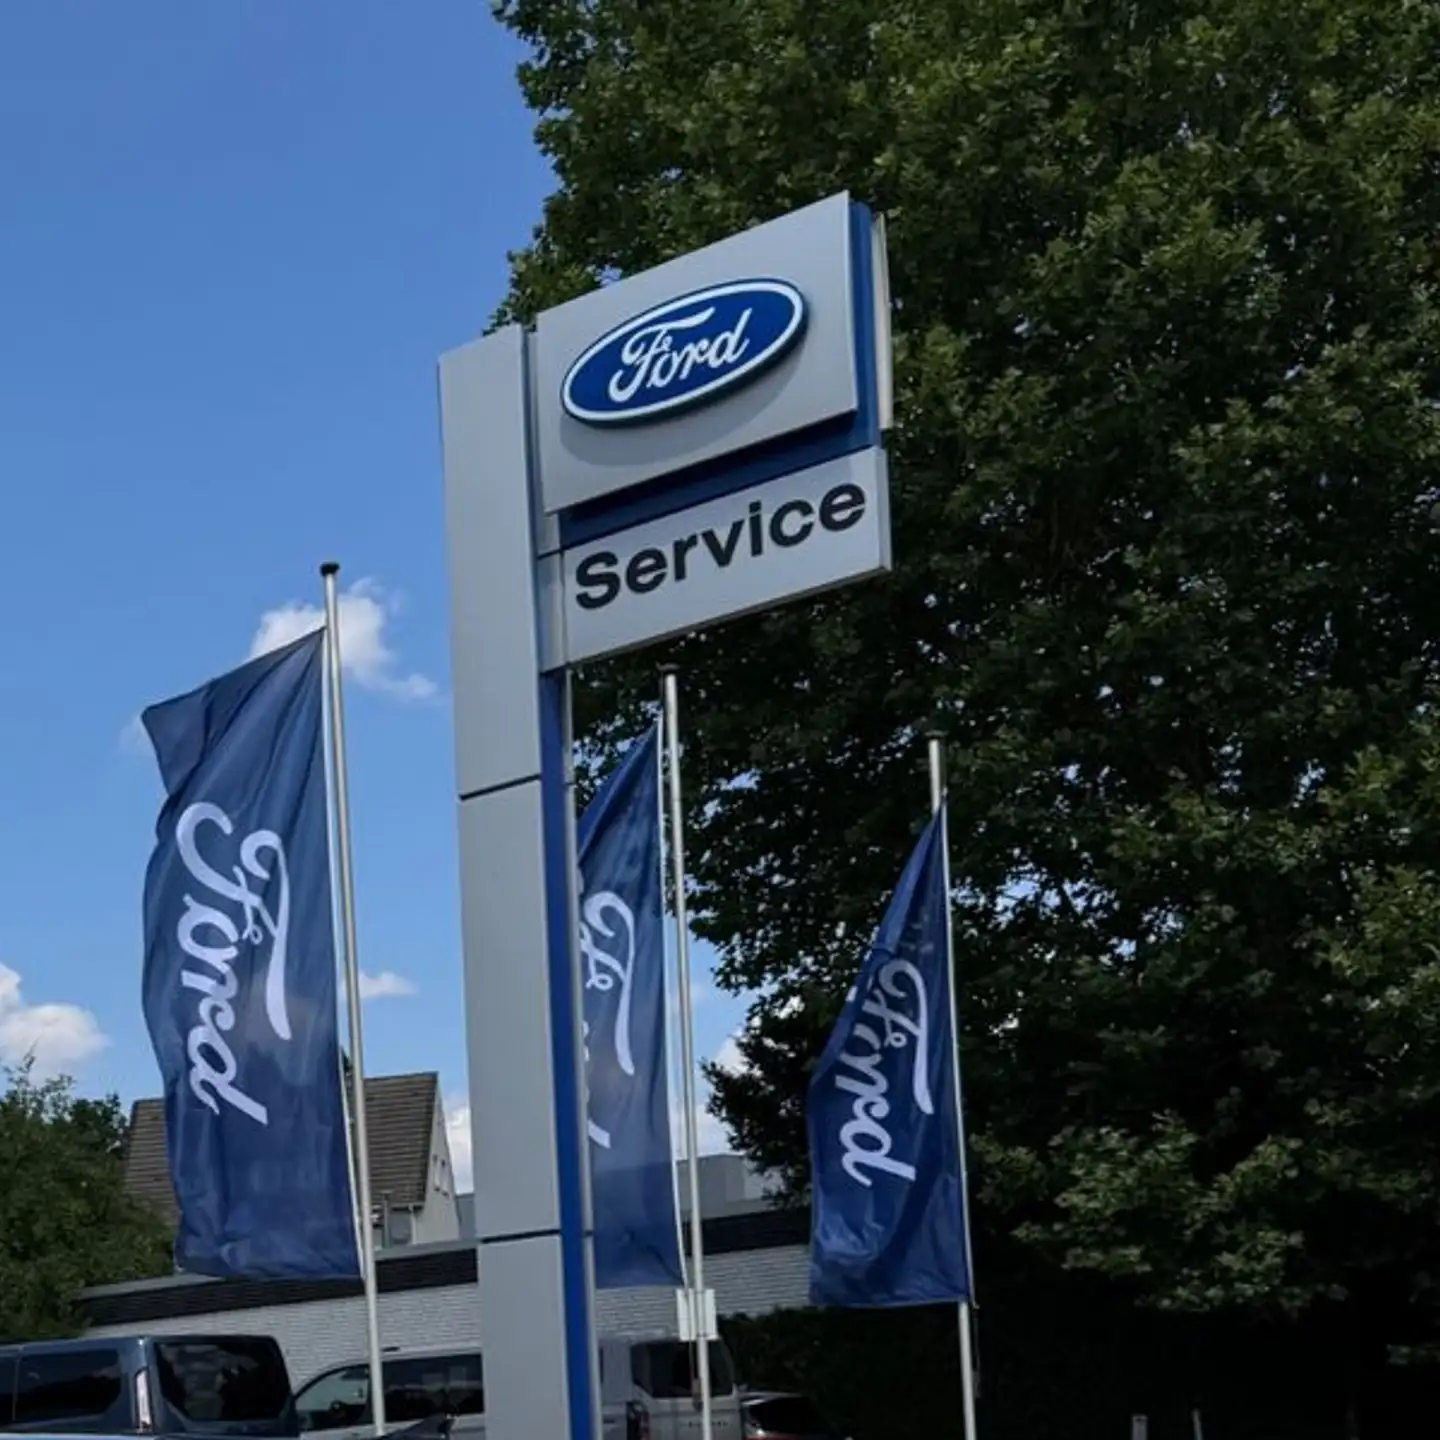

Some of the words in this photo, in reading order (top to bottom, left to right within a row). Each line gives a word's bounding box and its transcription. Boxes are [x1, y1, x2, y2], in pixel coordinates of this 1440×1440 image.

[607, 305, 754, 403] Ford
[574, 483, 866, 611] Service
[175, 801, 293, 1126] Ford
